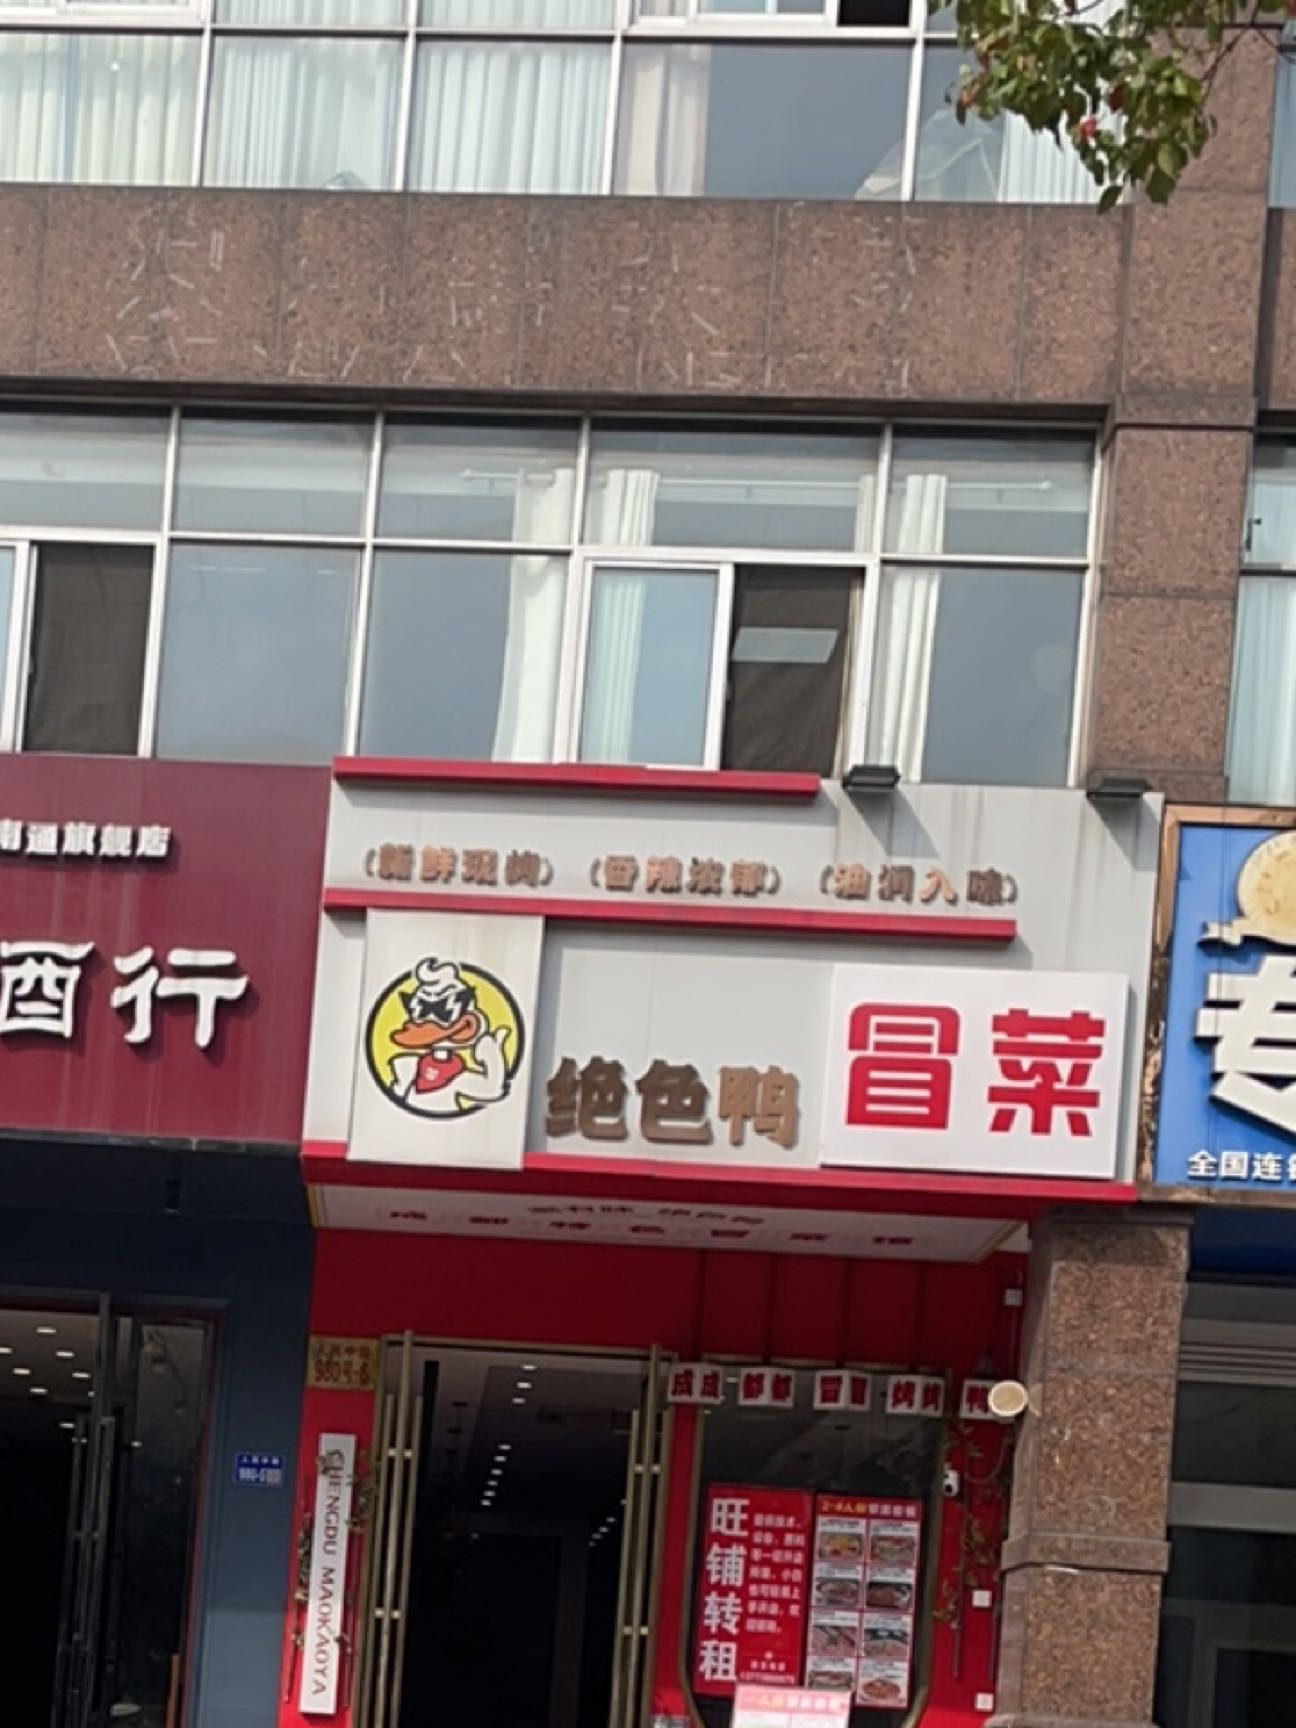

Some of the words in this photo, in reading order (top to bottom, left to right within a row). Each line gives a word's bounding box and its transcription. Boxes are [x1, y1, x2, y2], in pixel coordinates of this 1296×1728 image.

[544, 1056, 802, 1149] 绝色鸭
[846, 1002, 1106, 1138] 冒菜
[1186, 1149, 1296, 1183] 全国连
[700, 1498, 750, 1682] 旺铺转租
